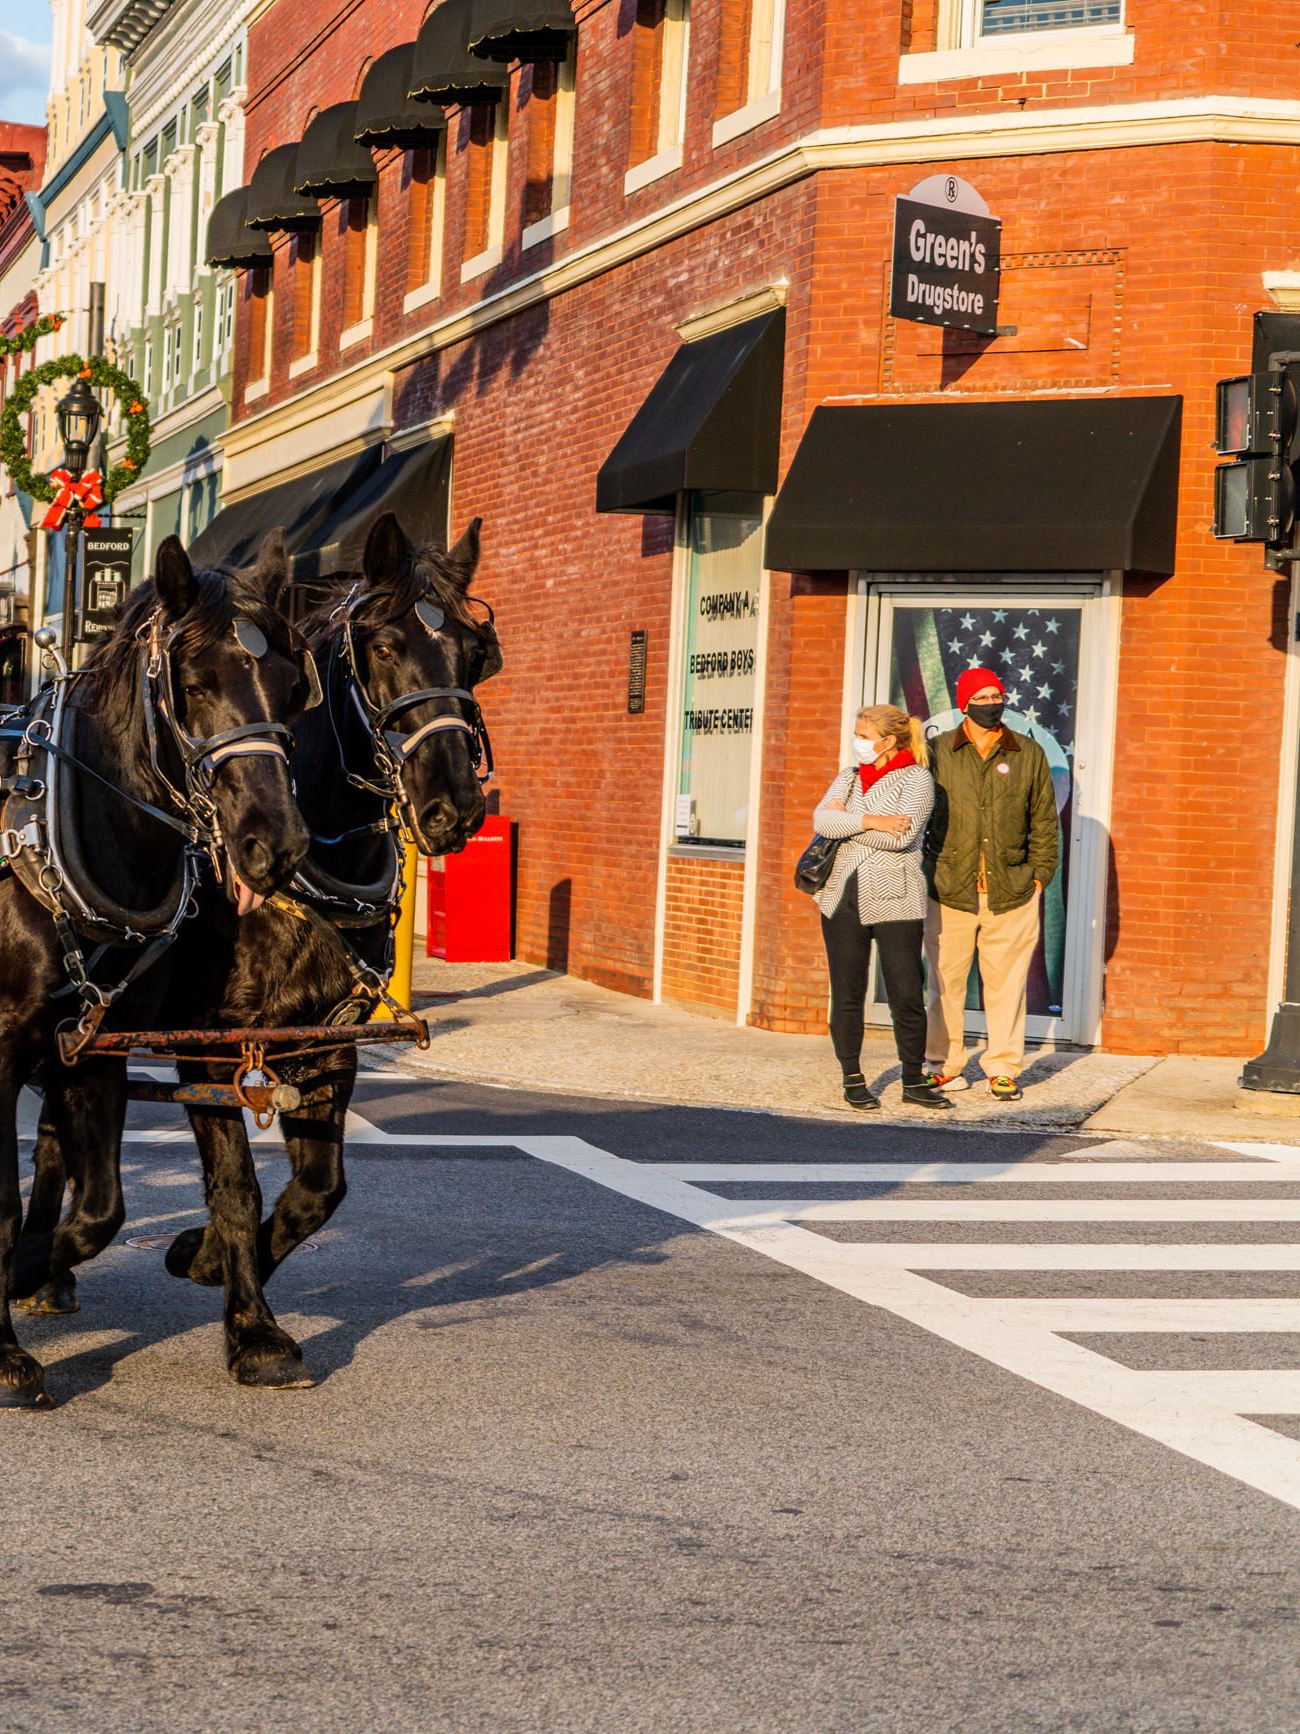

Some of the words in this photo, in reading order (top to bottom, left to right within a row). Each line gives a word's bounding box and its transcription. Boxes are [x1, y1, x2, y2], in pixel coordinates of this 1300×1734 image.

[909, 219, 986, 274] Green's
[907, 274, 984, 315] Drugstore
[87, 541, 130, 551] BEDFORD
[700, 591, 742, 616] COMPANY
[743, 590, 749, 610] A
[690, 651, 729, 674] BEDFORD
[730, 648, 754, 671] BOYS
[684, 710, 719, 730] TRIBUTE
